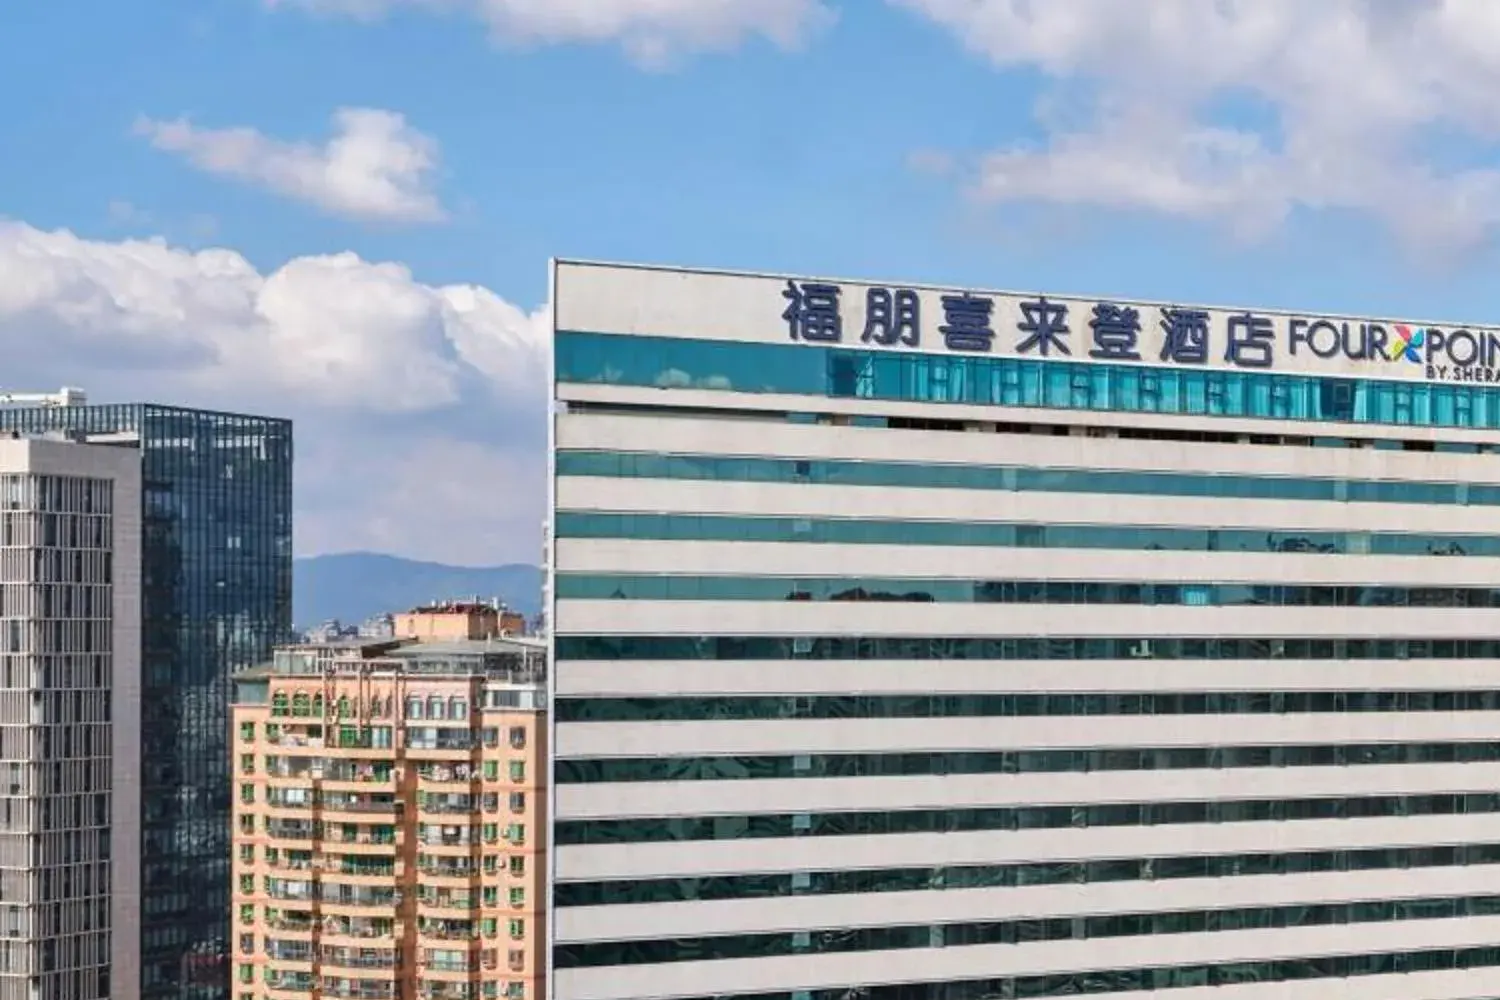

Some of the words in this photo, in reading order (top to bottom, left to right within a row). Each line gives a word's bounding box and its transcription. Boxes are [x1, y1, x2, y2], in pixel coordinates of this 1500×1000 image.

[781, 278, 1275, 367] 福朋喜来登酒店
[1289, 319, 1391, 361] FOUR
